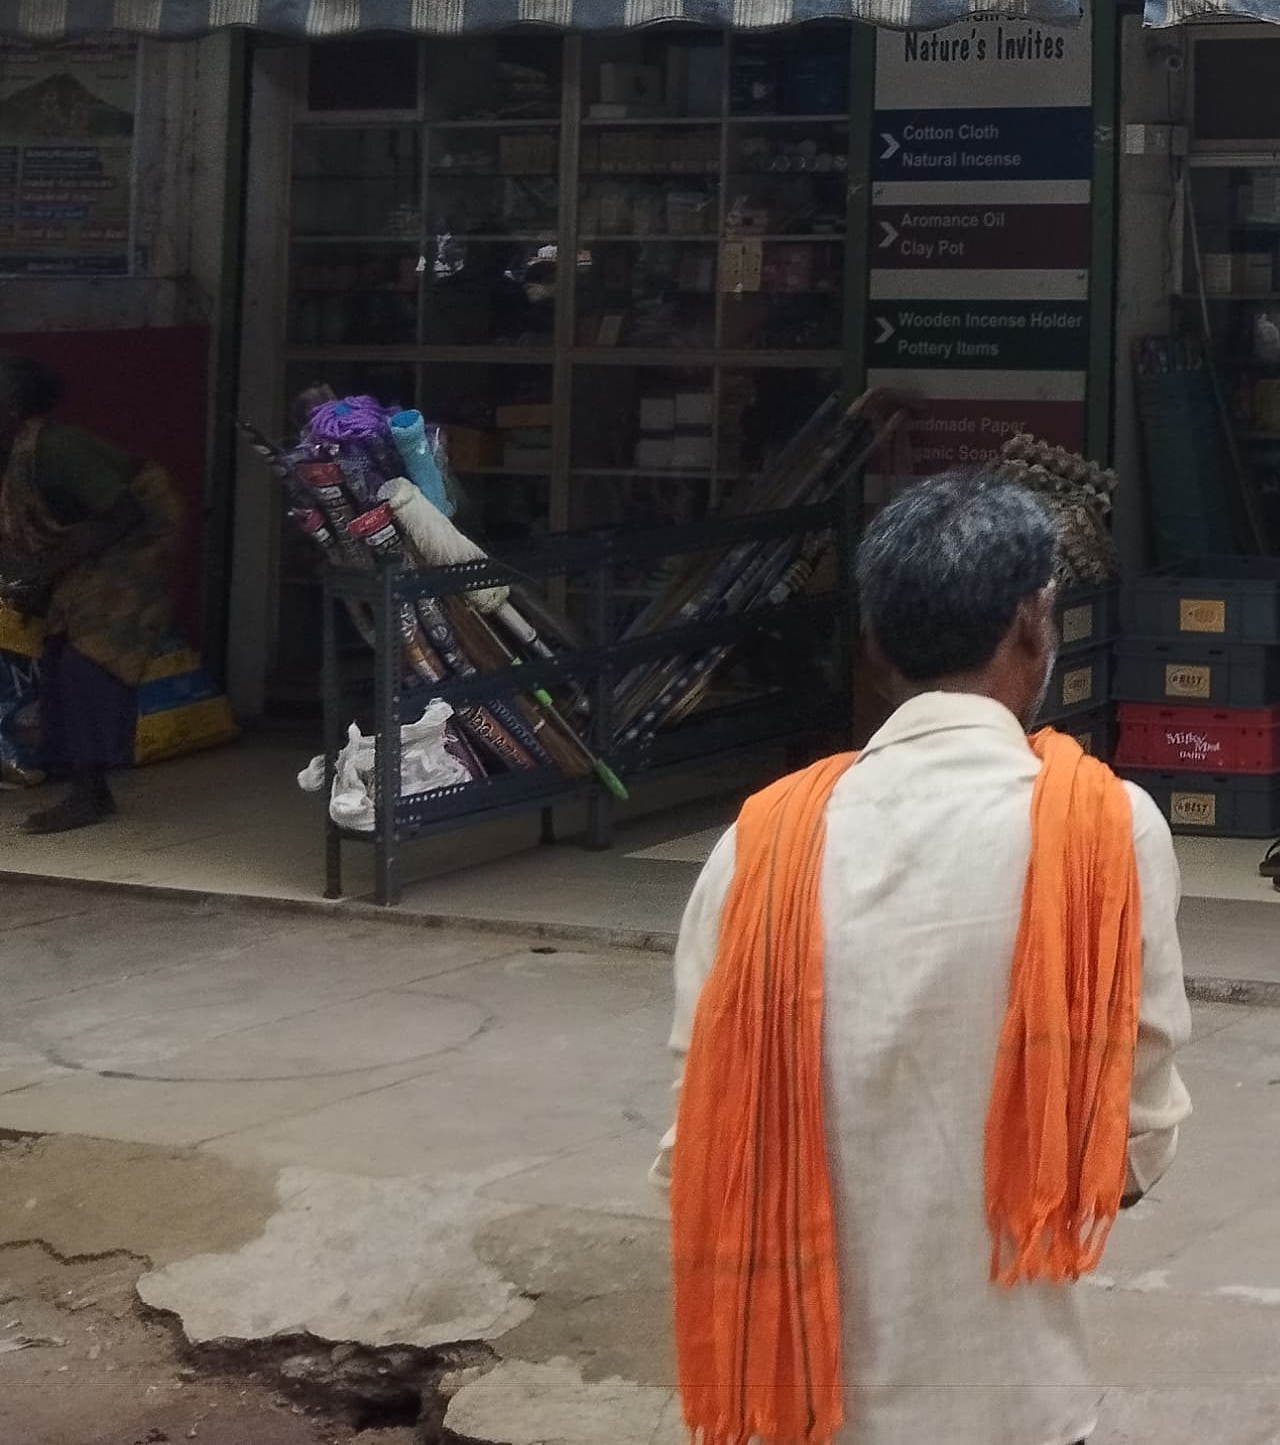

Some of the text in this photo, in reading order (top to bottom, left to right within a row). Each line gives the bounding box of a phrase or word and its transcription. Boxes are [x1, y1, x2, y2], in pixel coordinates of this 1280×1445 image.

[904, 26, 1065, 63] Nature's Invites
[902, 123, 1000, 141] Cotton Cloth
[901, 152, 1022, 168] Natural Incense
[900, 211, 1006, 228] Aromance Oil
[900, 239, 965, 258] Clay Pot
[898, 311, 1083, 329] Wooden Incense Holder
[897, 339, 1001, 360] Pottery Items
